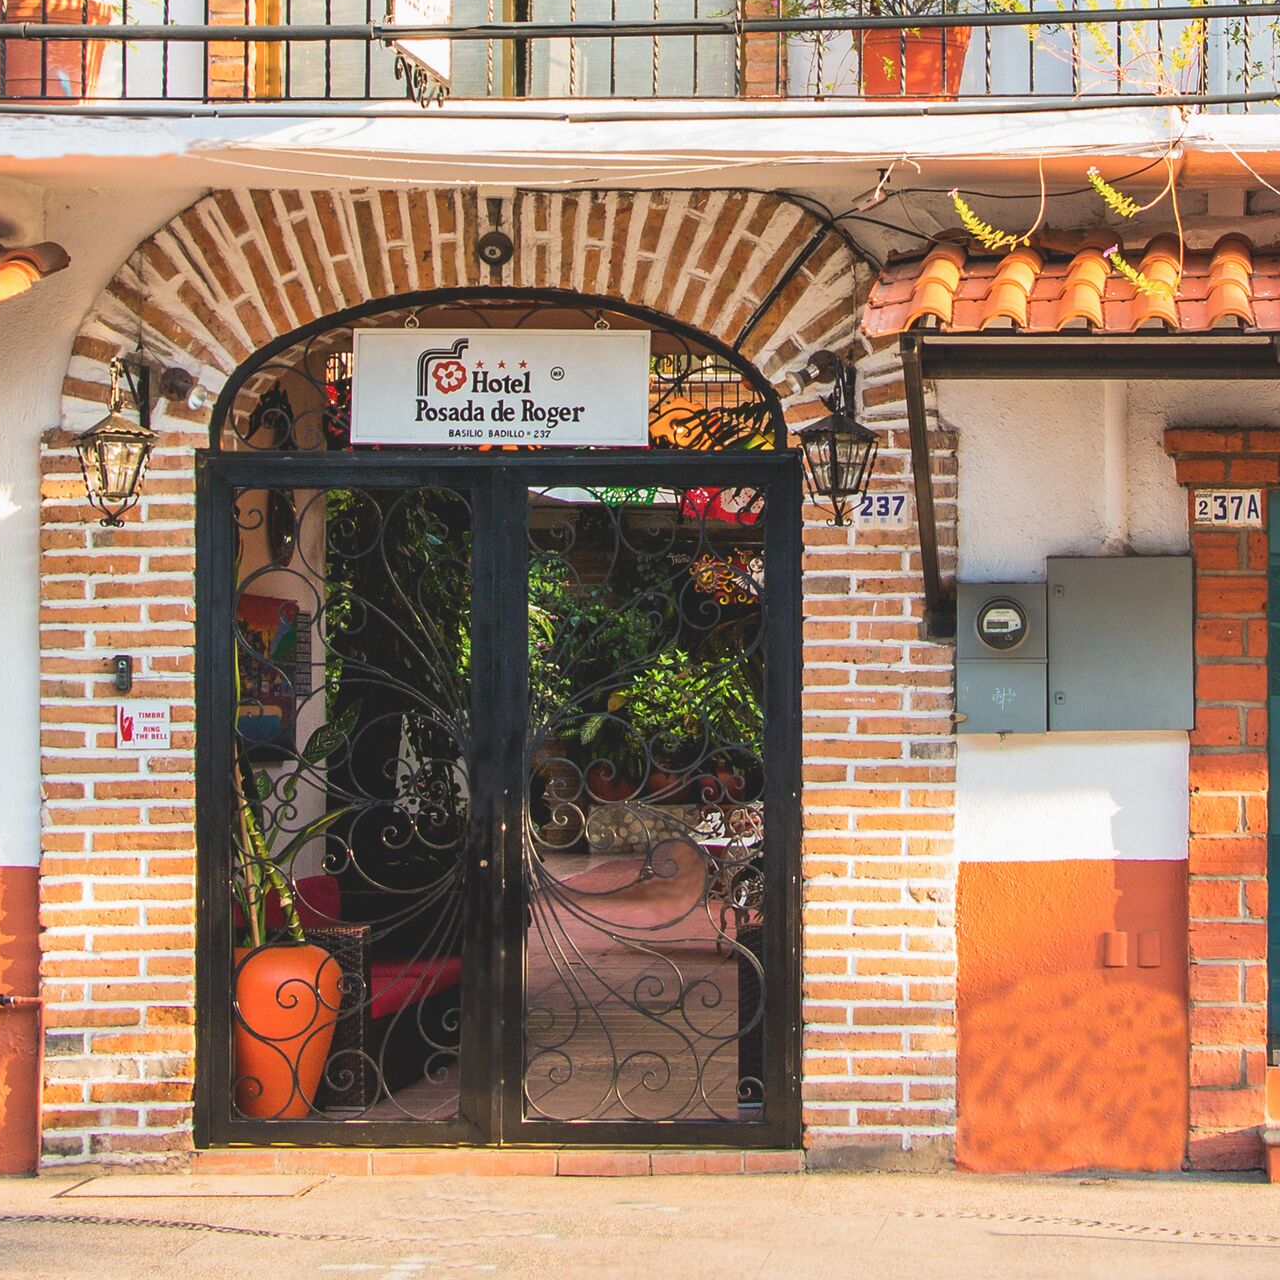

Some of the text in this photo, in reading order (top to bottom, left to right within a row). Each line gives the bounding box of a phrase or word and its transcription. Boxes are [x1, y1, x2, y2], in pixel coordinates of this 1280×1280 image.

[471, 371, 531, 394] Hotel
[415, 399, 585, 428] Posada de Roger
[448, 429, 551, 438] BASILIO BADILLO 237
[860, 495, 905, 517] 237
[1199, 494, 1260, 520] 237A
